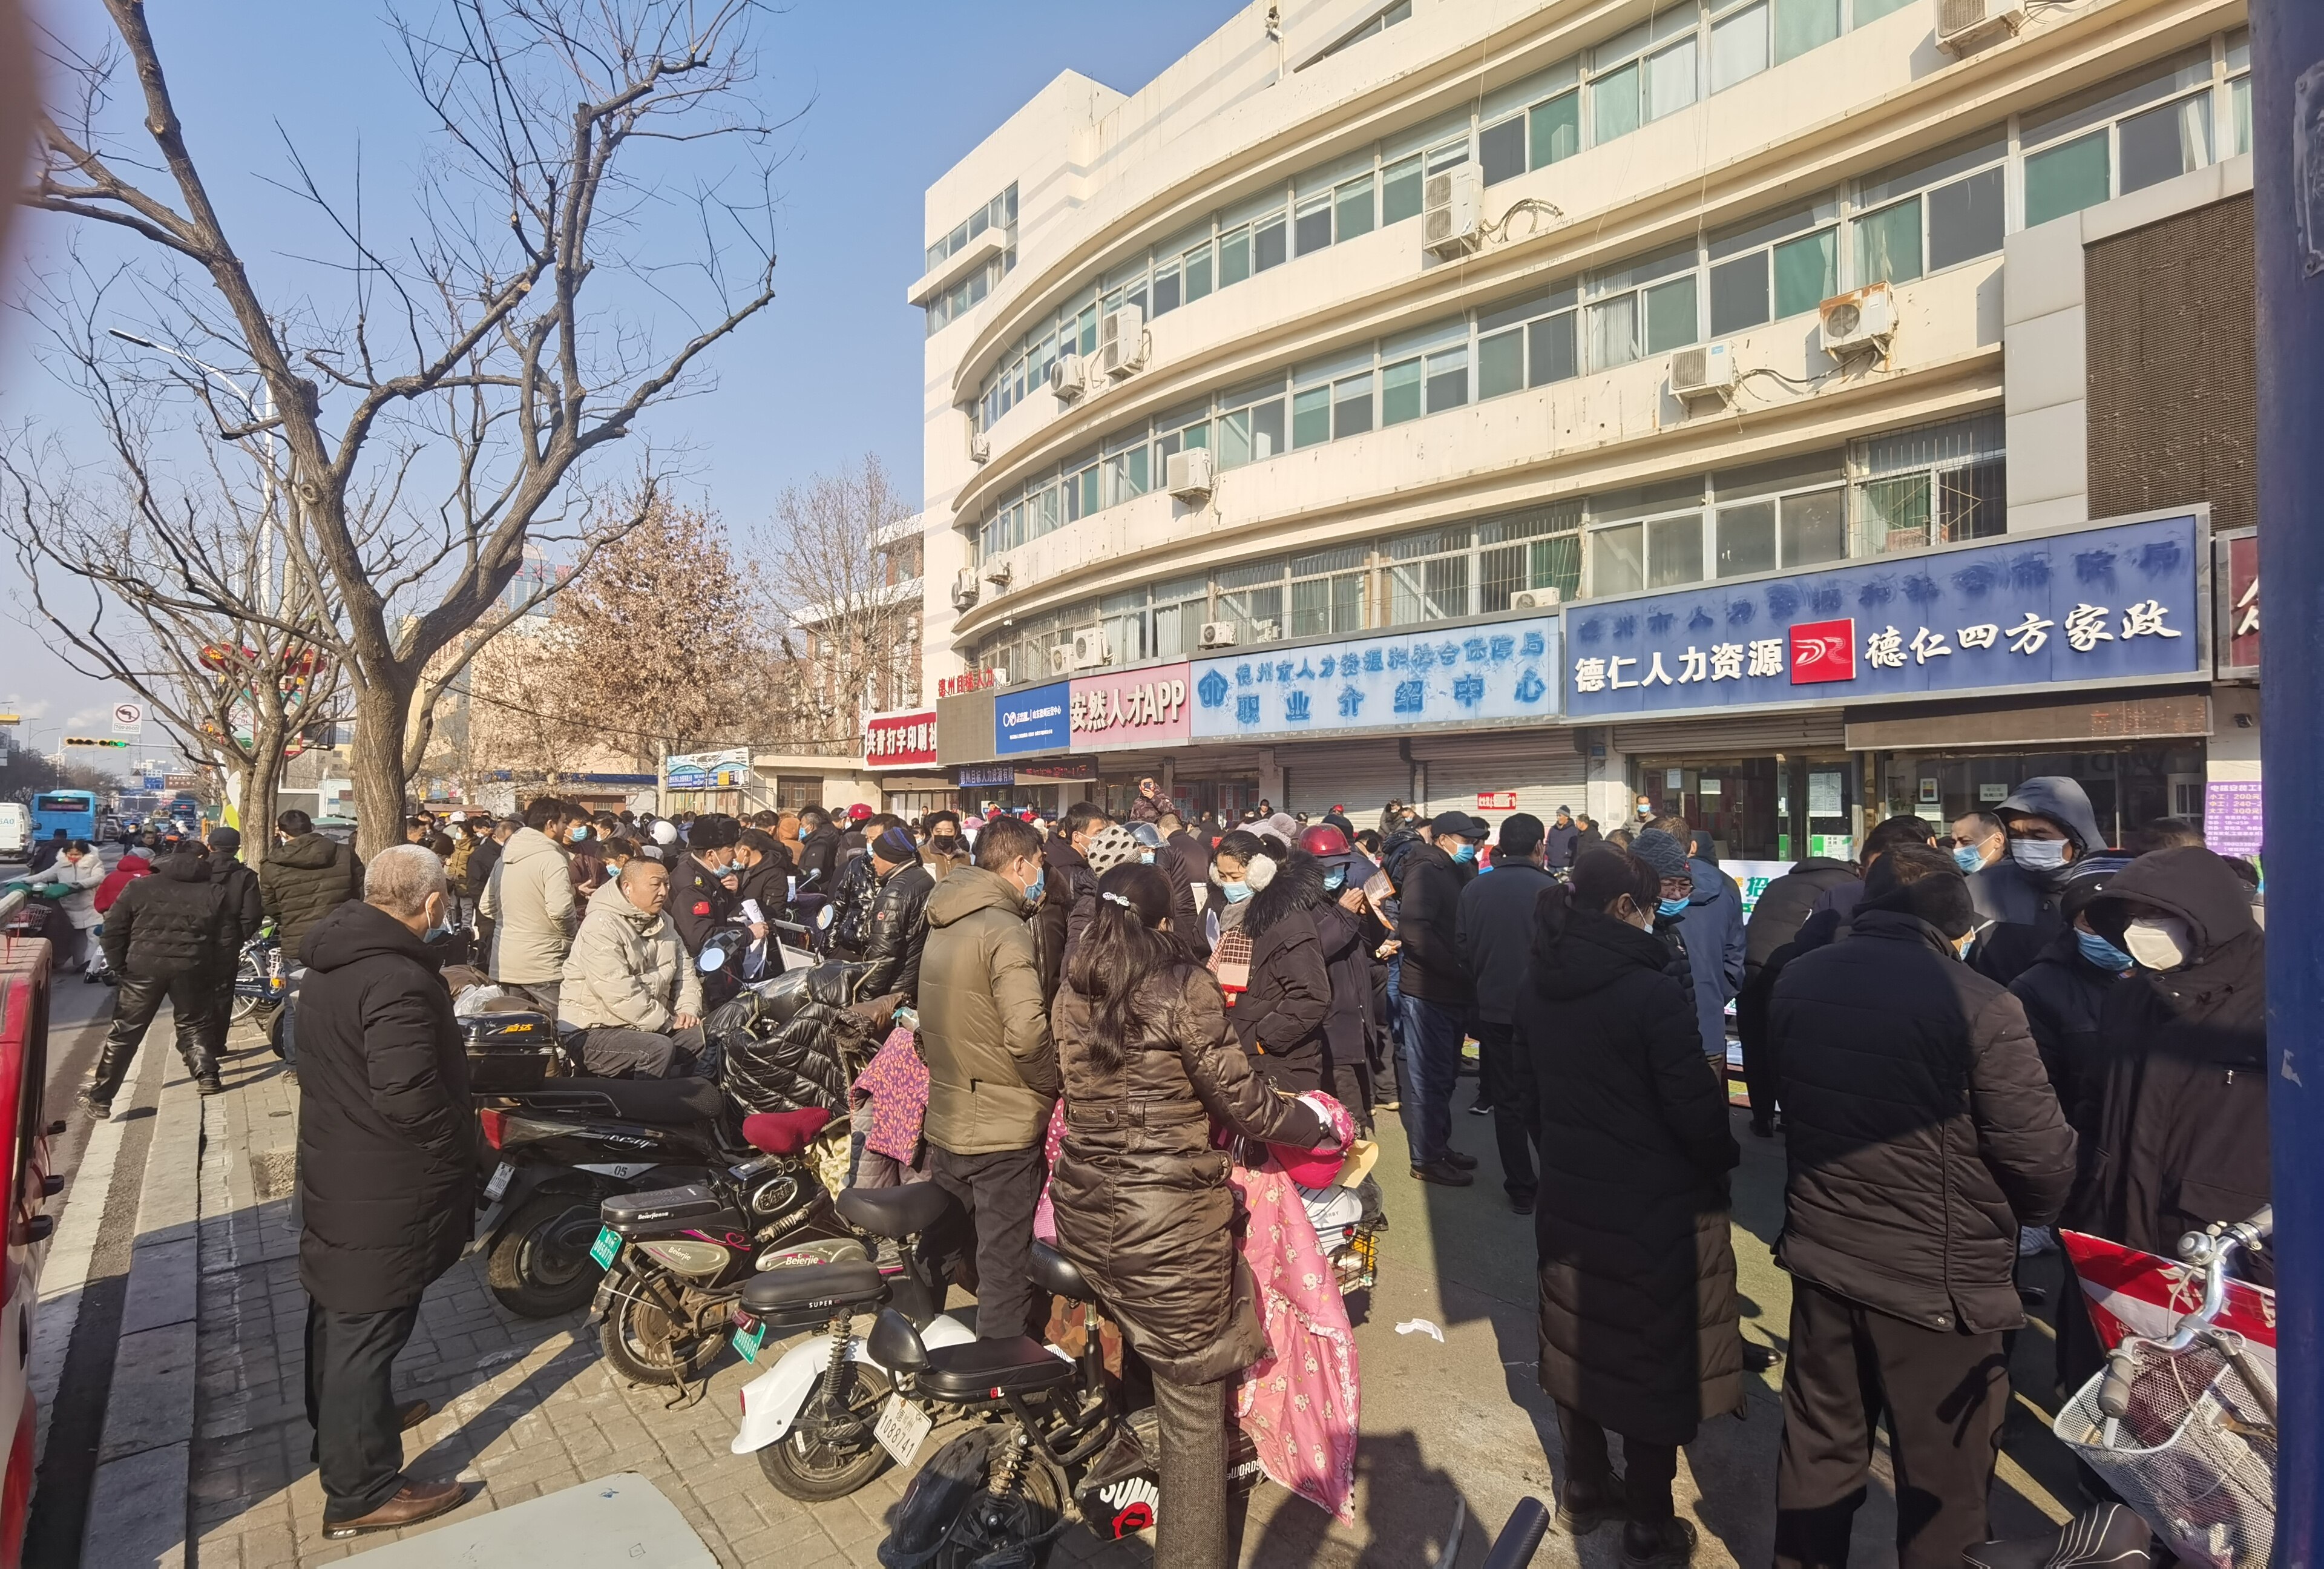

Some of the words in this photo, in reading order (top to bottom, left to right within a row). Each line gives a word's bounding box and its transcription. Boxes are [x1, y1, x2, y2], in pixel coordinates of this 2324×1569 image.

[1865, 599, 2182, 669] 德仁四方家政
[1574, 638, 1784, 692] 德仁人力资源
[1071, 679, 1186, 732] 安然人才APP
[614, 1165, 628, 1177] 05
[668, 1246, 691, 1261] Beierjie
[786, 1253, 819, 1266] Beierjie
[809, 1300, 833, 1308] SUPER
[880, 1415, 915, 1458] 1088741
